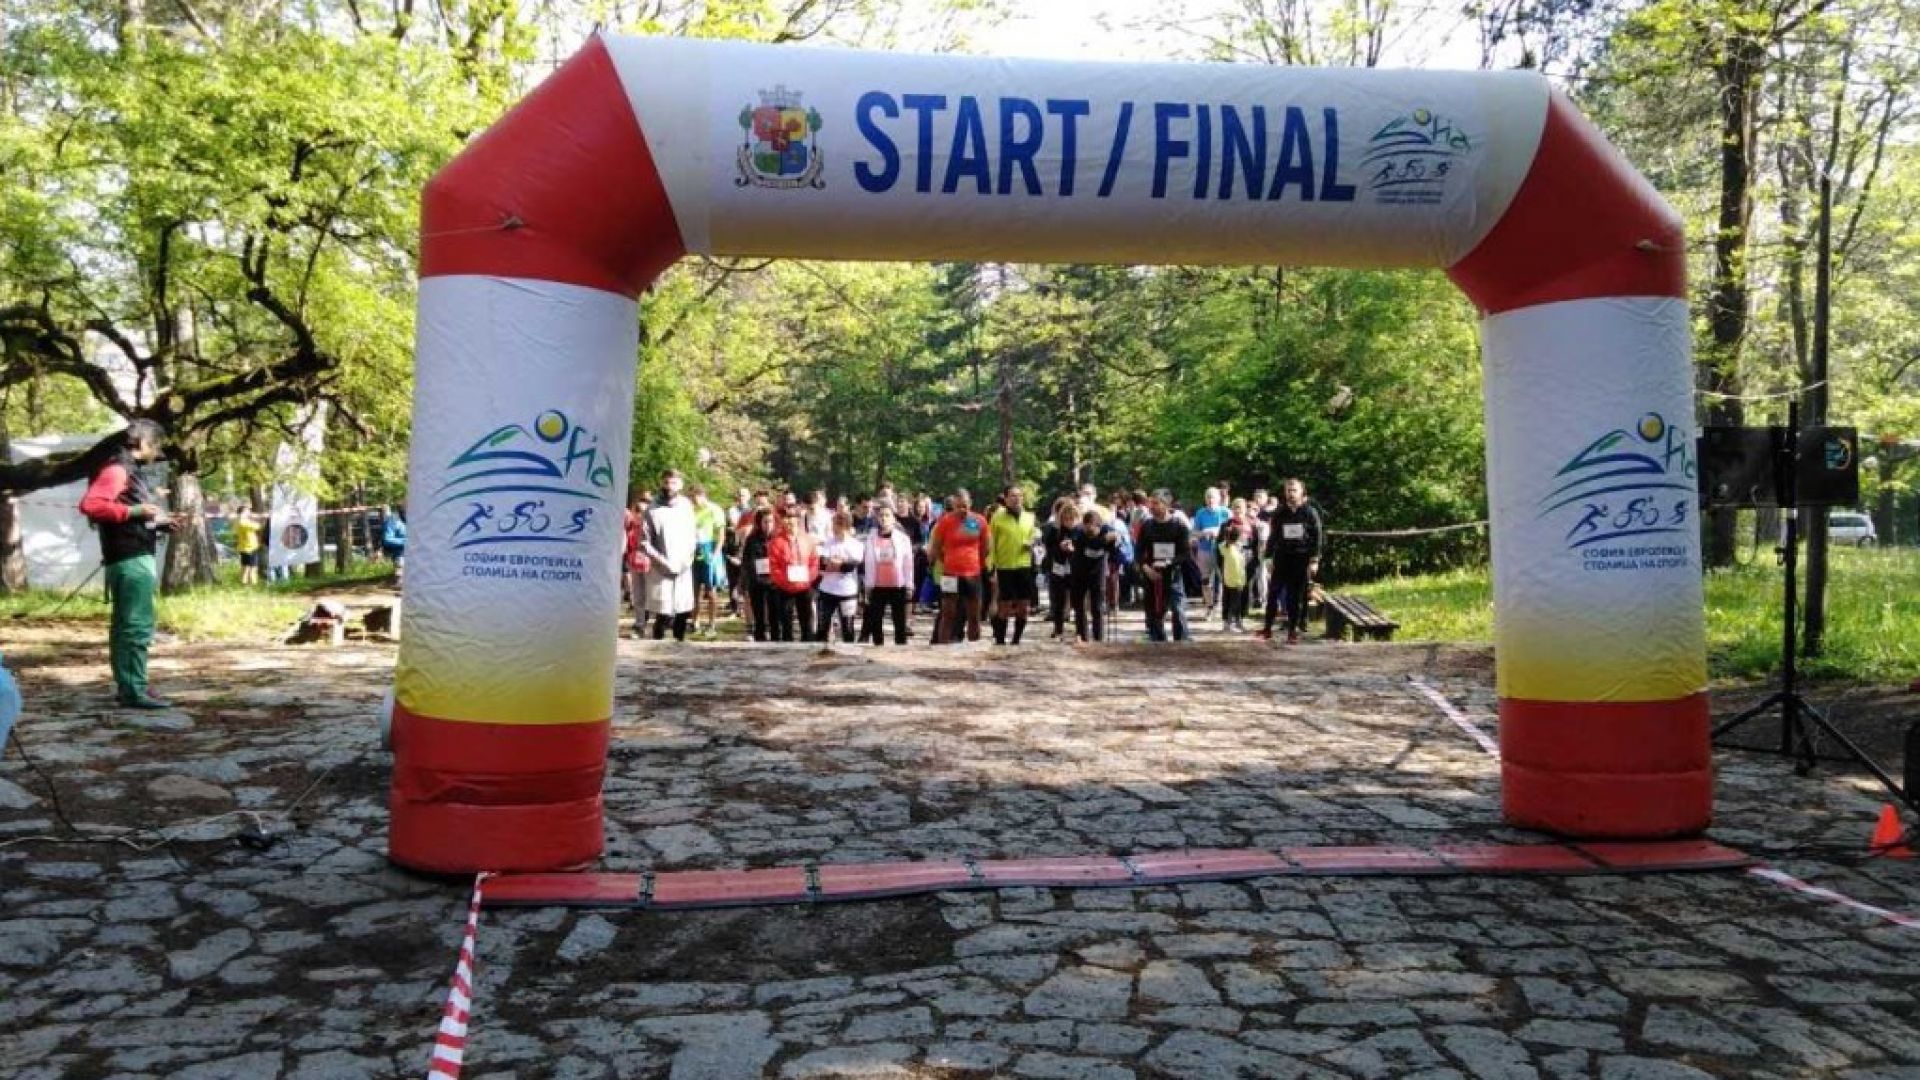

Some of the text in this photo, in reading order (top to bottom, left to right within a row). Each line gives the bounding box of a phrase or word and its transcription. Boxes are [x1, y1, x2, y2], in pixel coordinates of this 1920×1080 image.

[853, 91, 1359, 203] START / FINAL
